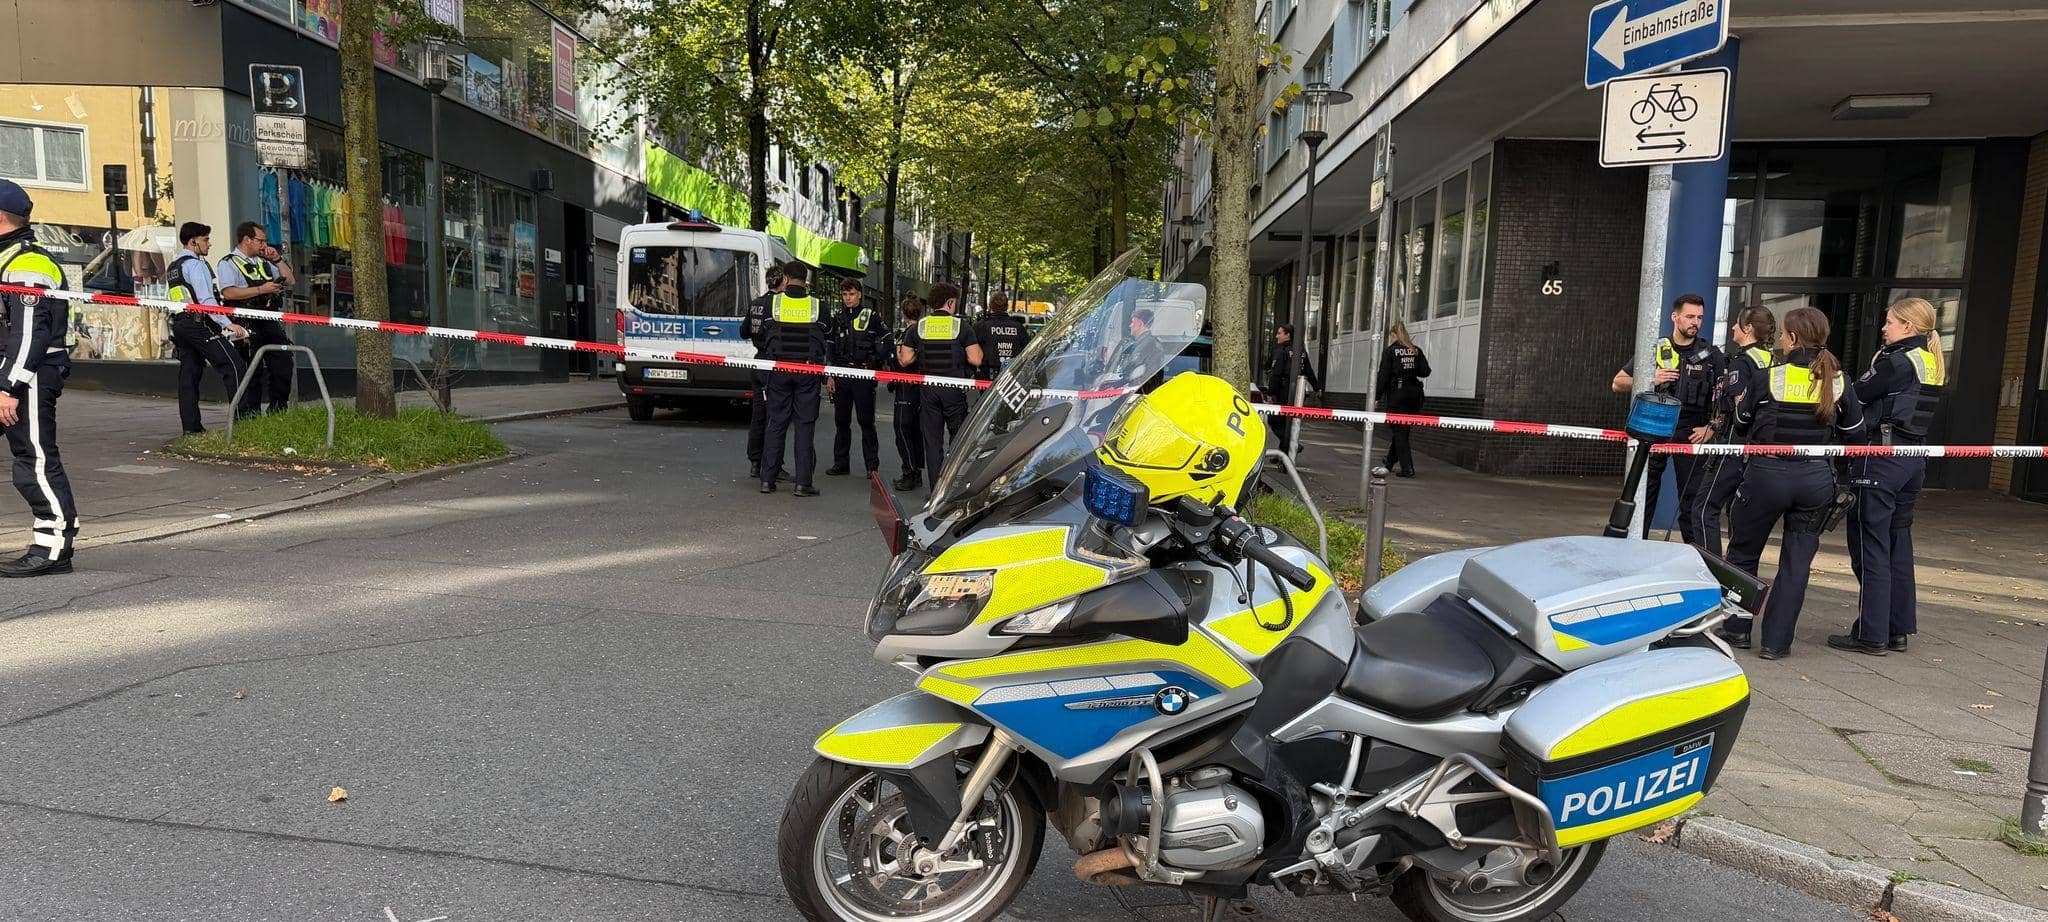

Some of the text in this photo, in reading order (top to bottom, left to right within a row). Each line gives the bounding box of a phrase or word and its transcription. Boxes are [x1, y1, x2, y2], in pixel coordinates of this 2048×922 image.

[1623, 1, 1714, 46] Einbahnstraße
[174, 113, 223, 138] mbs
[273, 121, 286, 129] mit
[258, 128, 303, 140] Parkschein
[261, 144, 299, 152] Bewohner
[1541, 279, 1563, 295] 65
[783, 308, 808, 318] POLIZEI
[632, 321, 686, 335] POLIZEI
[991, 326, 1018, 336] POLIZEI
[997, 342, 1012, 350] NRW
[1560, 757, 1699, 822] POLIZEI
